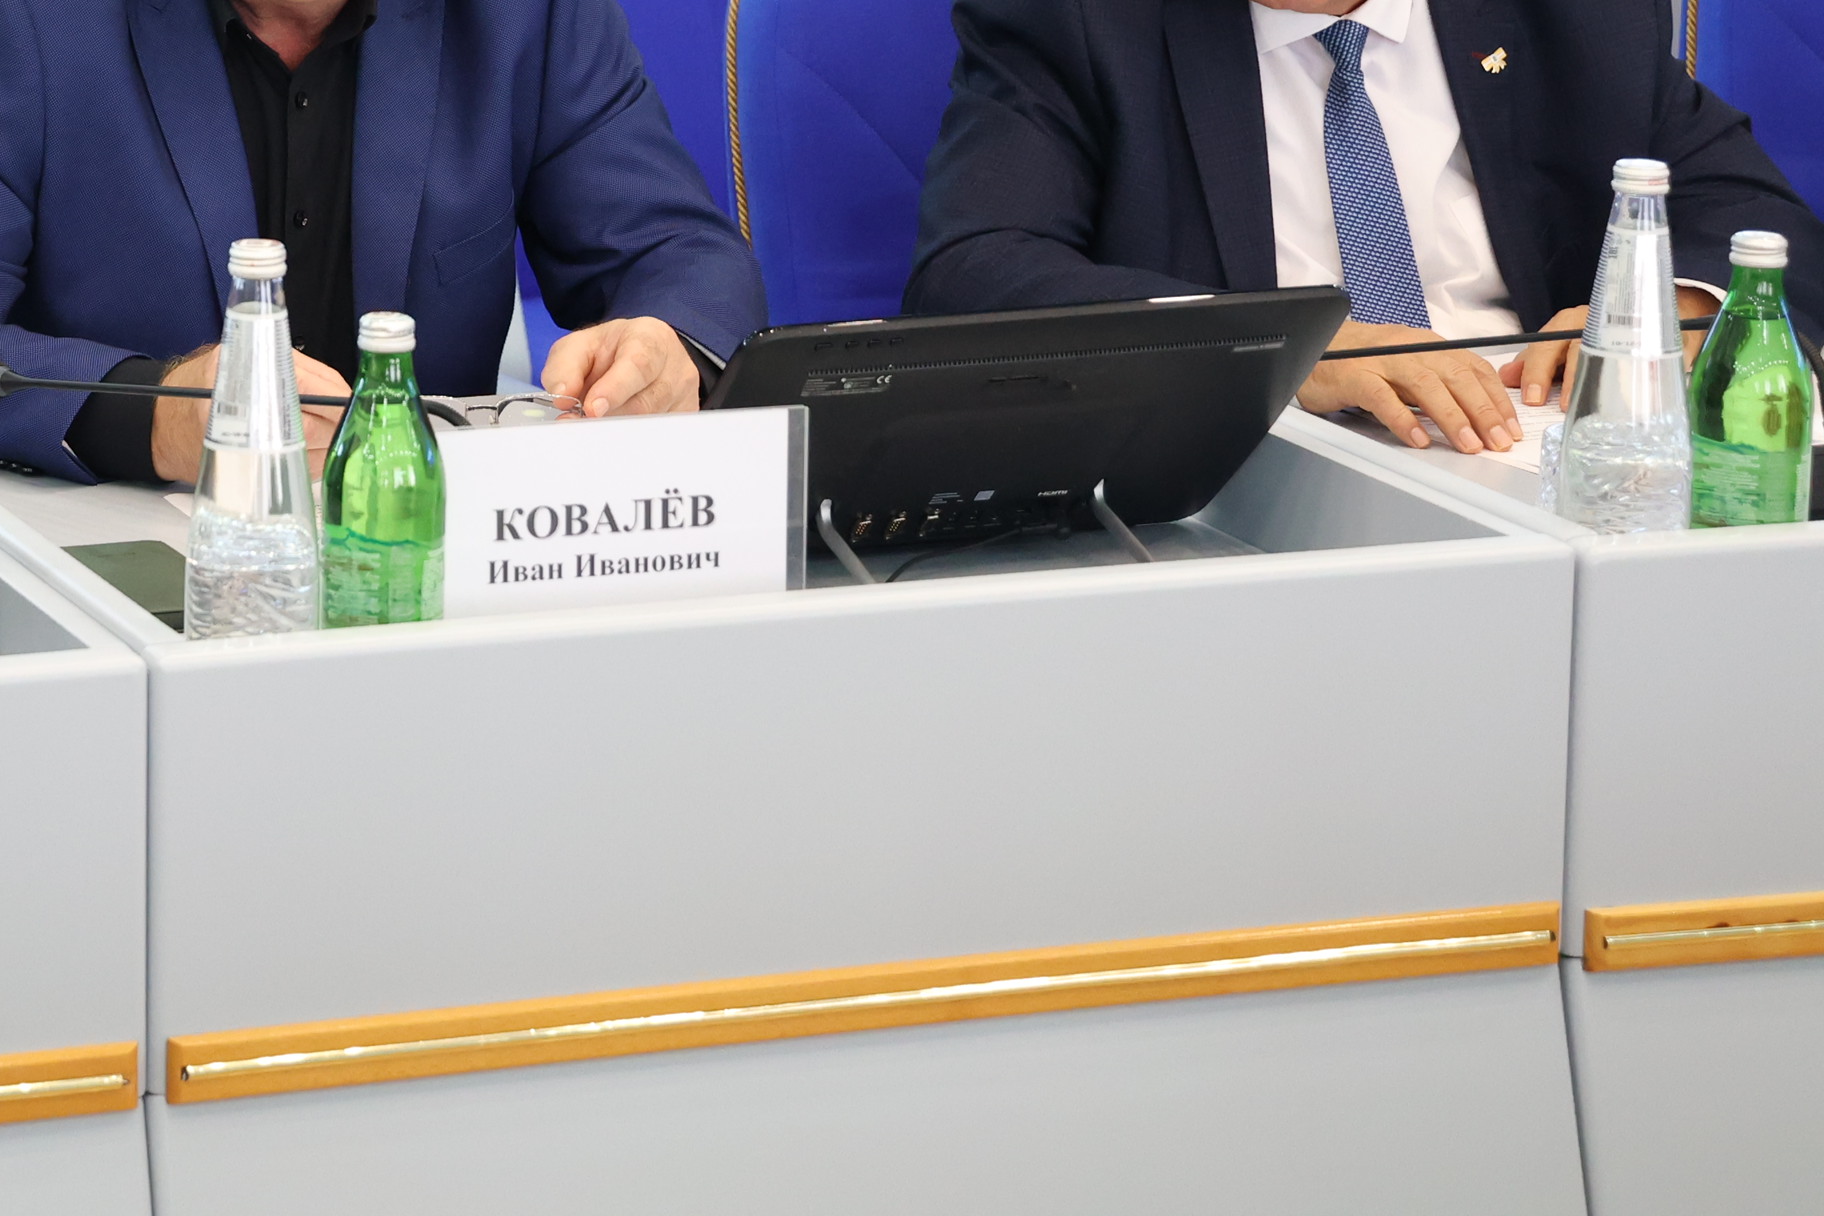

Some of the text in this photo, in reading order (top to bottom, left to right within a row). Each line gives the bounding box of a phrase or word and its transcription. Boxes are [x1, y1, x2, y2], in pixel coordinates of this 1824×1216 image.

[494, 487, 717, 543] КОВАЛЁВ
[487, 550, 721, 585] Иван Иванович
